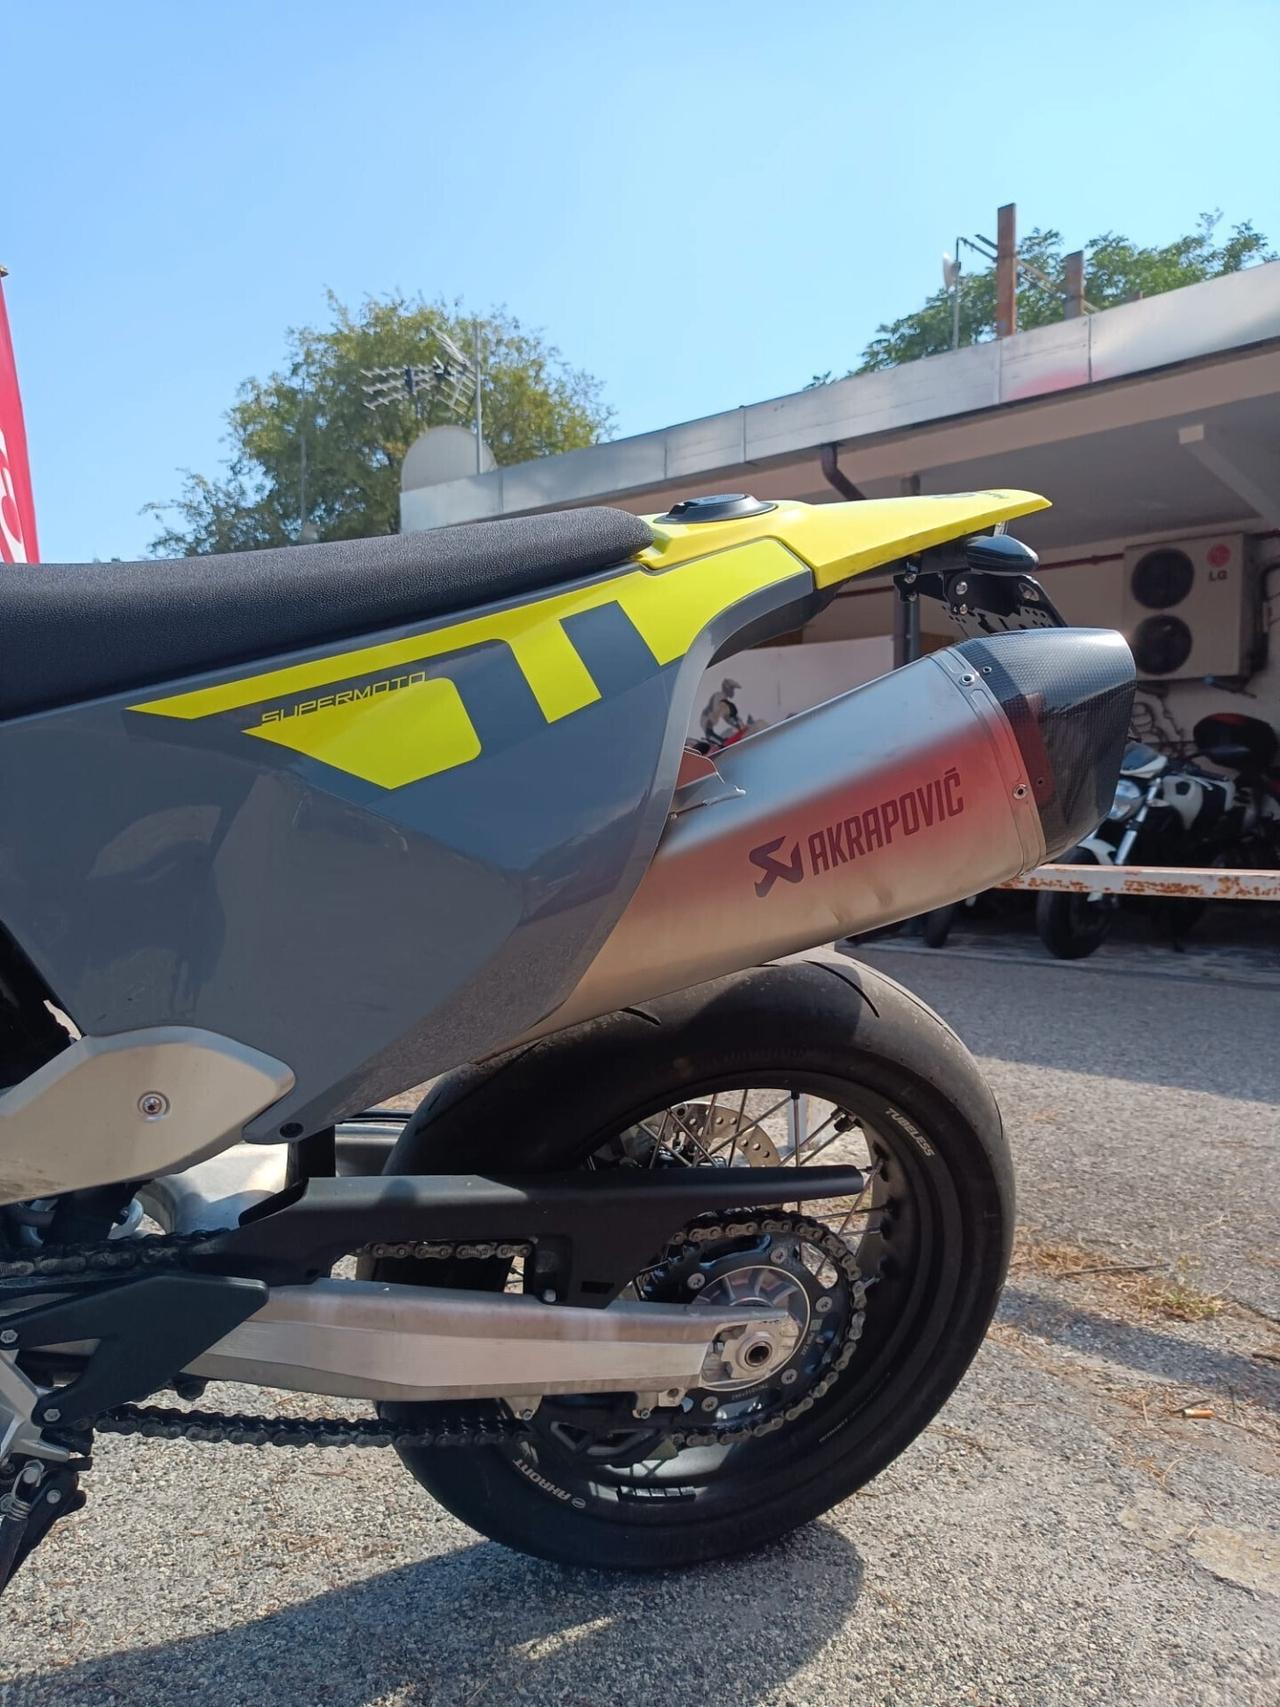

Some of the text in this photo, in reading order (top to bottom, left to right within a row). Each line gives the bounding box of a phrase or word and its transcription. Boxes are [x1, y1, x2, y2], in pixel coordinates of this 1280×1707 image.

[1209, 570, 1228, 582] LG
[261, 671, 426, 723] SUPERMOTO
[885, 1107, 936, 1157] TUBELESS
